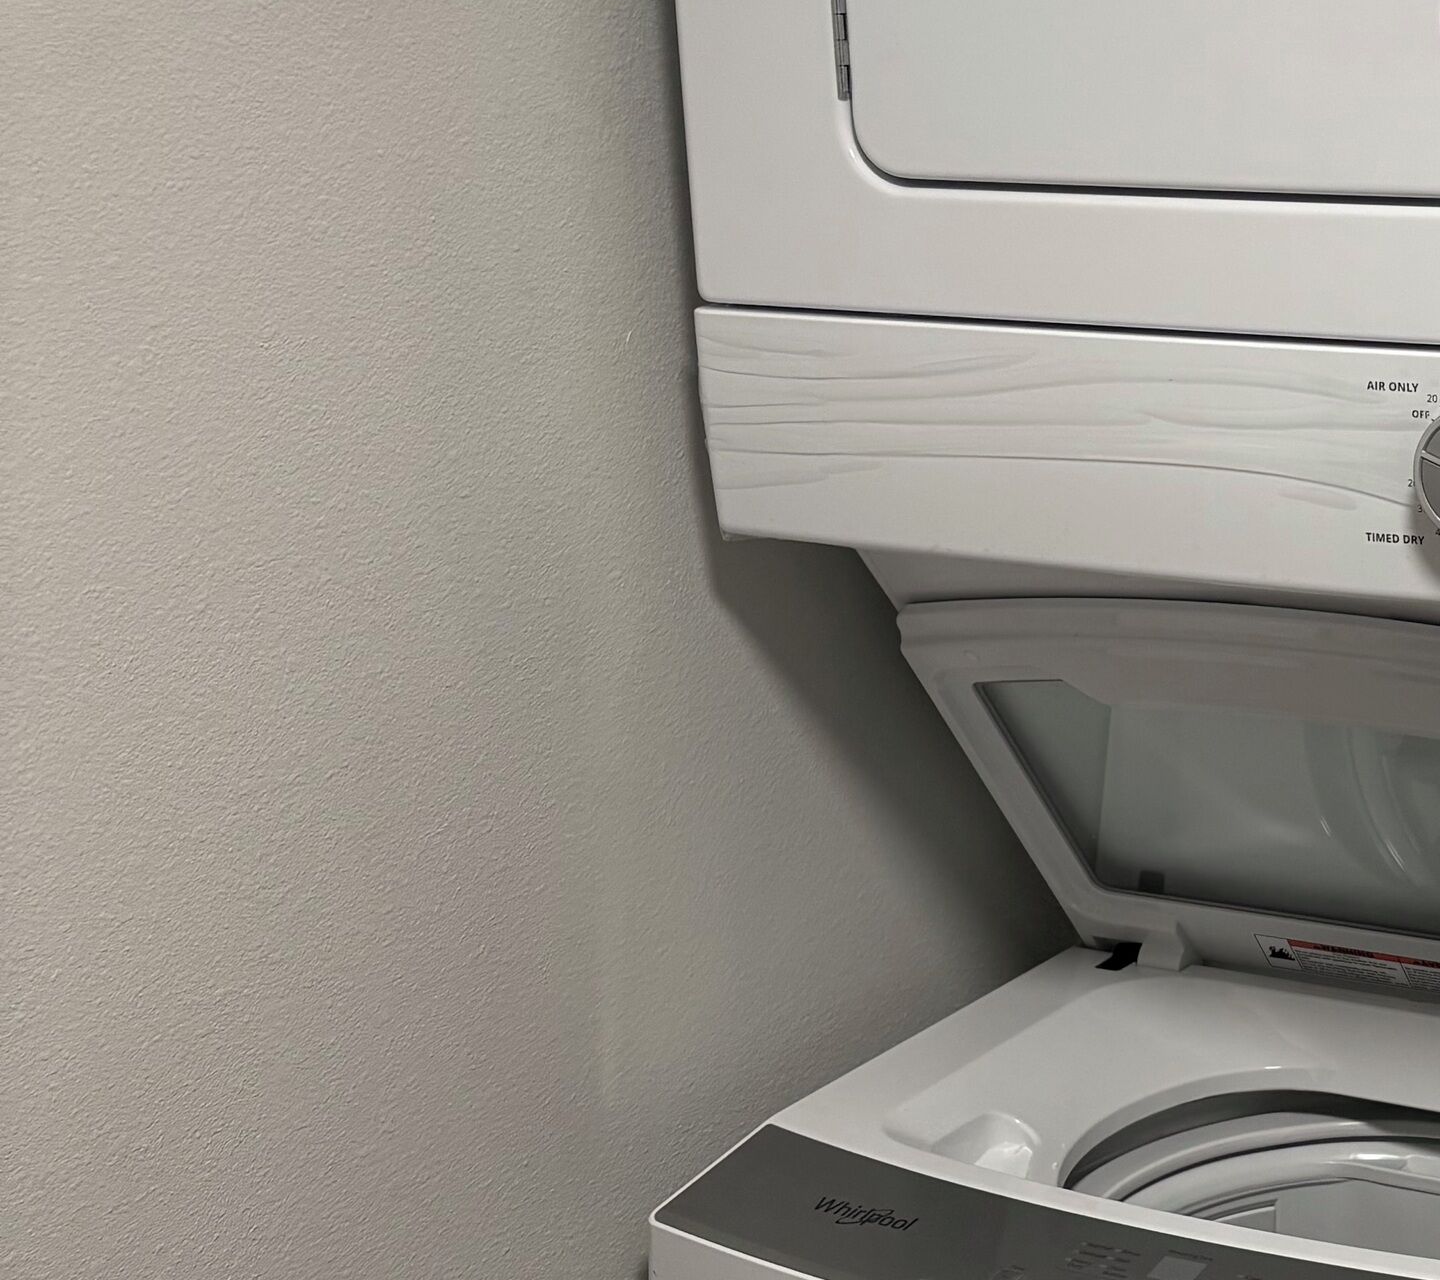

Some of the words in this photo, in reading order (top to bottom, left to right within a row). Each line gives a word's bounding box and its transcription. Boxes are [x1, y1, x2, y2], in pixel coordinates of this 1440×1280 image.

[1366, 380, 1386, 391] AIR
[1388, 381, 1419, 393] ONLY
[1426, 393, 1438, 403] 20
[1411, 409, 1430, 419] OFF
[1407, 478, 1415, 488] 2
[1365, 532, 1400, 544] TIMED
[1403, 534, 1425, 545] DRY
[814, 1196, 919, 1231] Whirlpool
